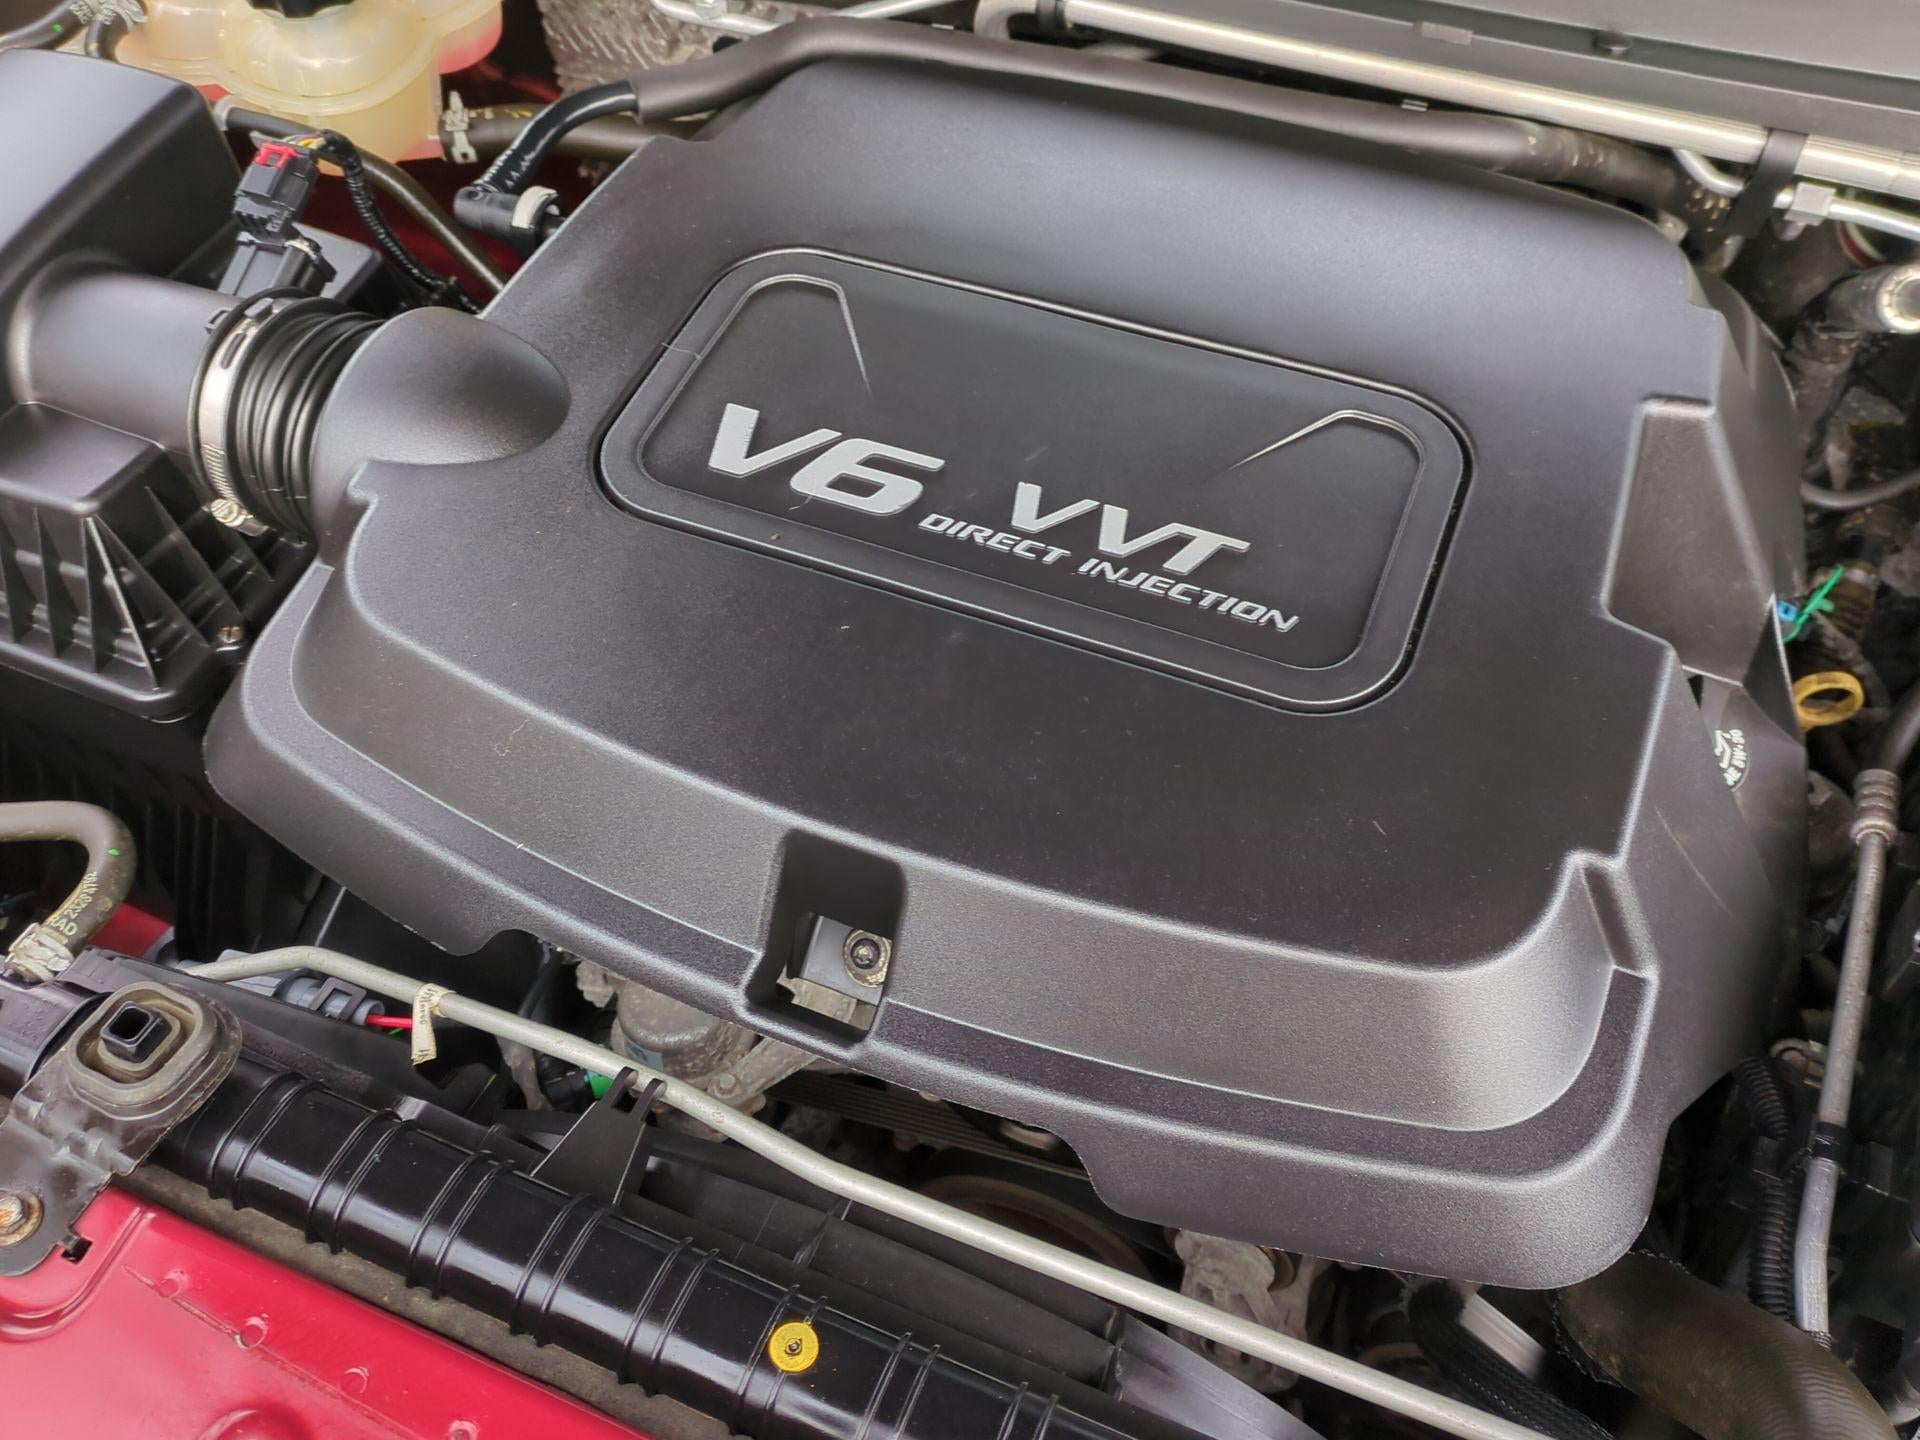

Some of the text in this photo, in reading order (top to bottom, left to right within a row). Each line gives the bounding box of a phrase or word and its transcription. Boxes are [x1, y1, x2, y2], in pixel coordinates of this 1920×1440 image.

[708, 402, 945, 517] V6
[918, 512, 1300, 632] DIRECT INJECTION
[1011, 481, 1251, 576] VVT
